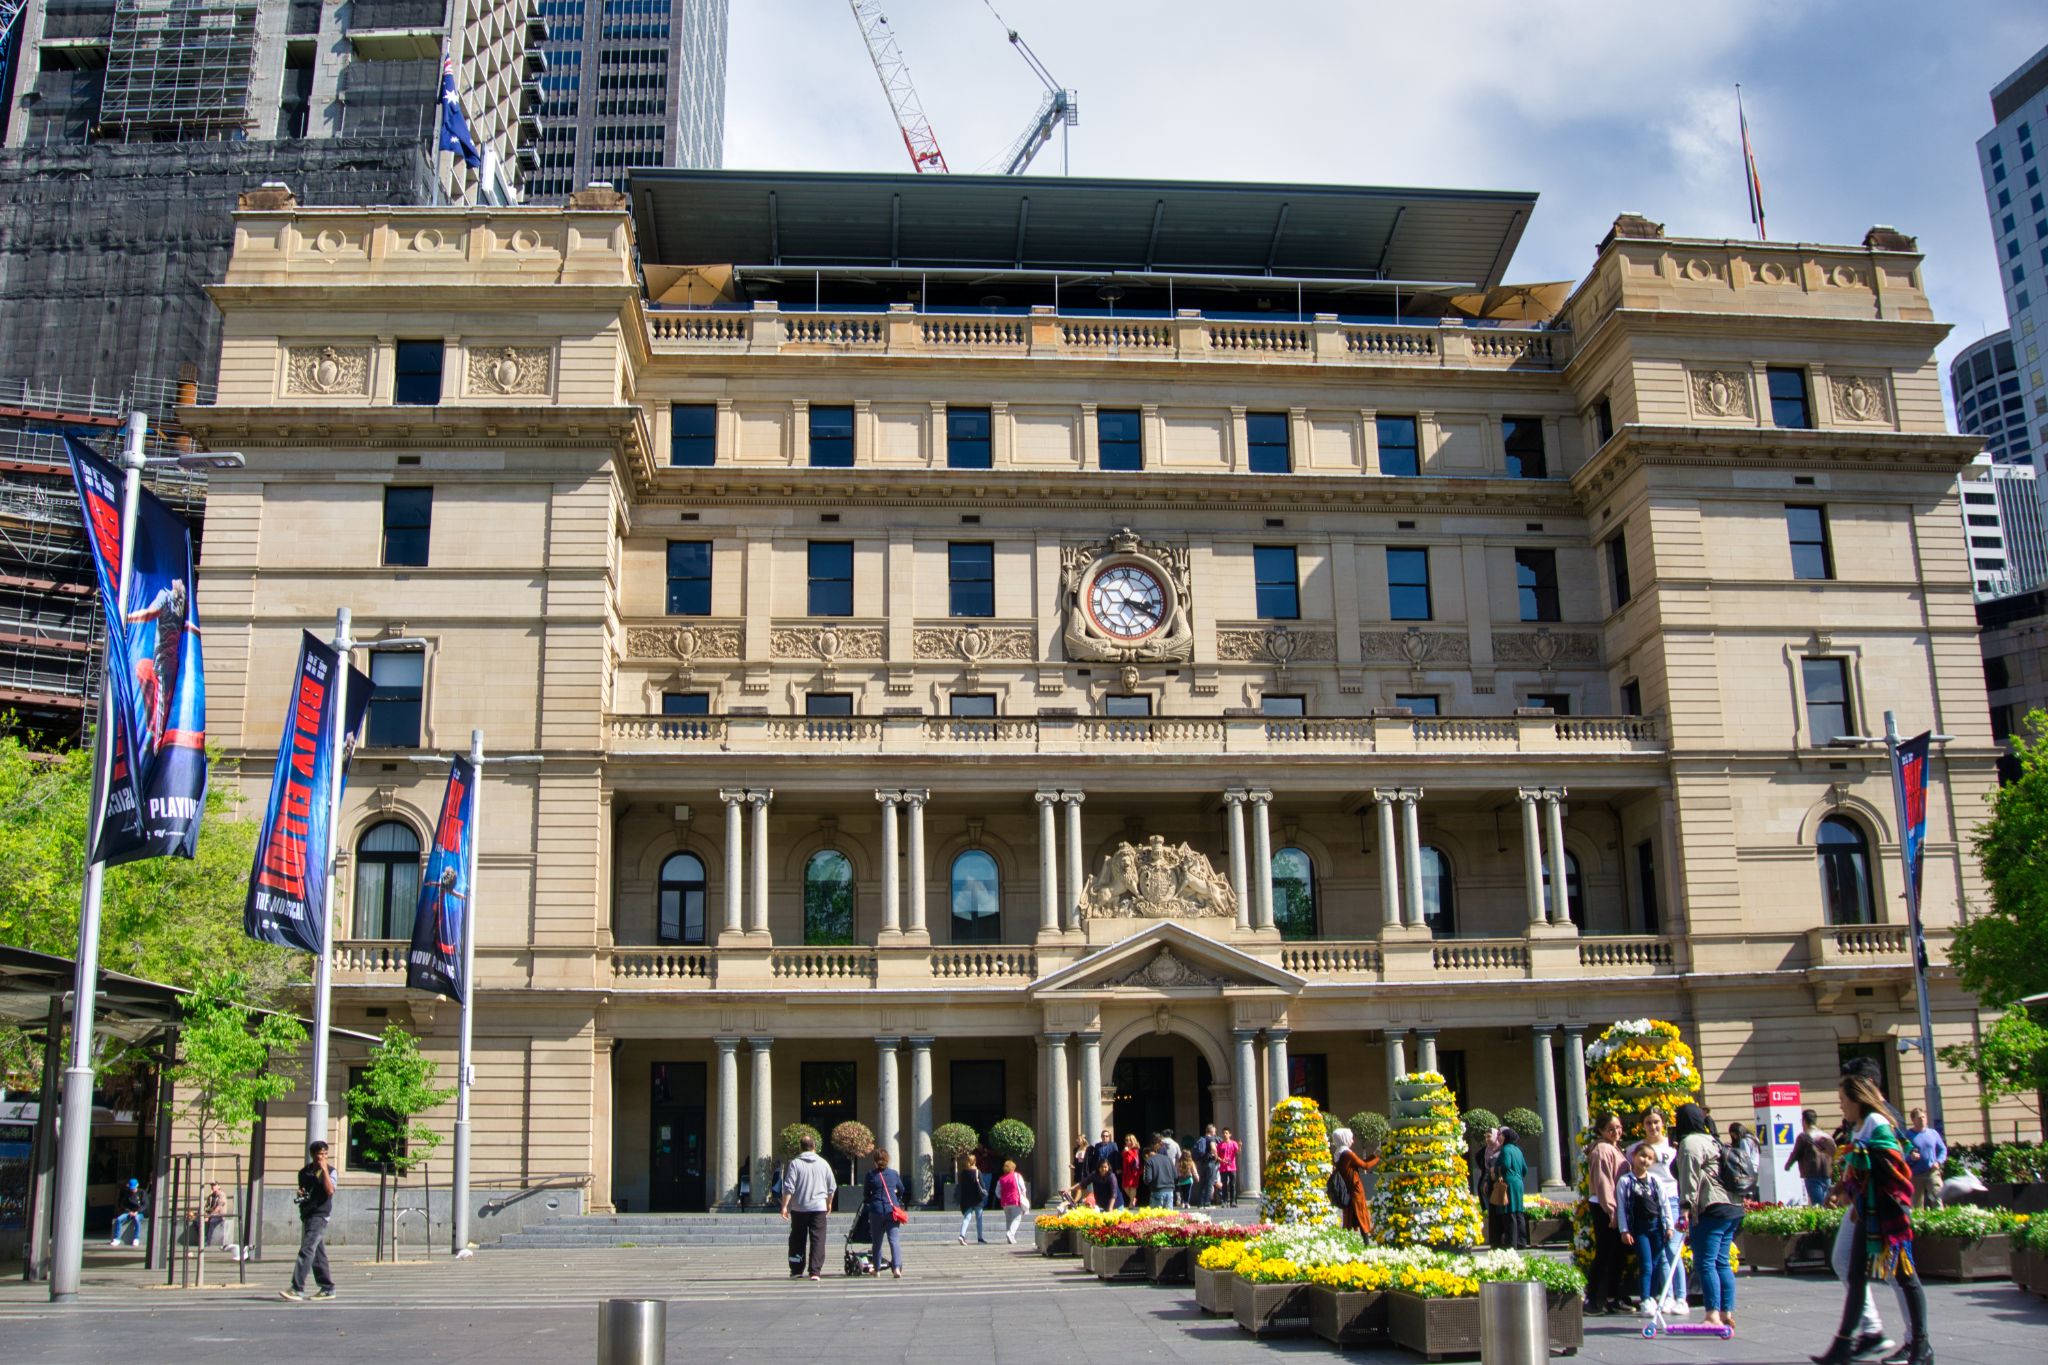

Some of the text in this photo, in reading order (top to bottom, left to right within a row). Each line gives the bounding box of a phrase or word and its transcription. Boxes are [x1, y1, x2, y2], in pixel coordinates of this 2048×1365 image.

[291, 675, 325, 779] BILLY
[150, 796, 200, 820] PLAYIN
[256, 891, 271, 911] THE
[411, 950, 431, 966] NOW
[432, 955, 455, 979] PAYING
